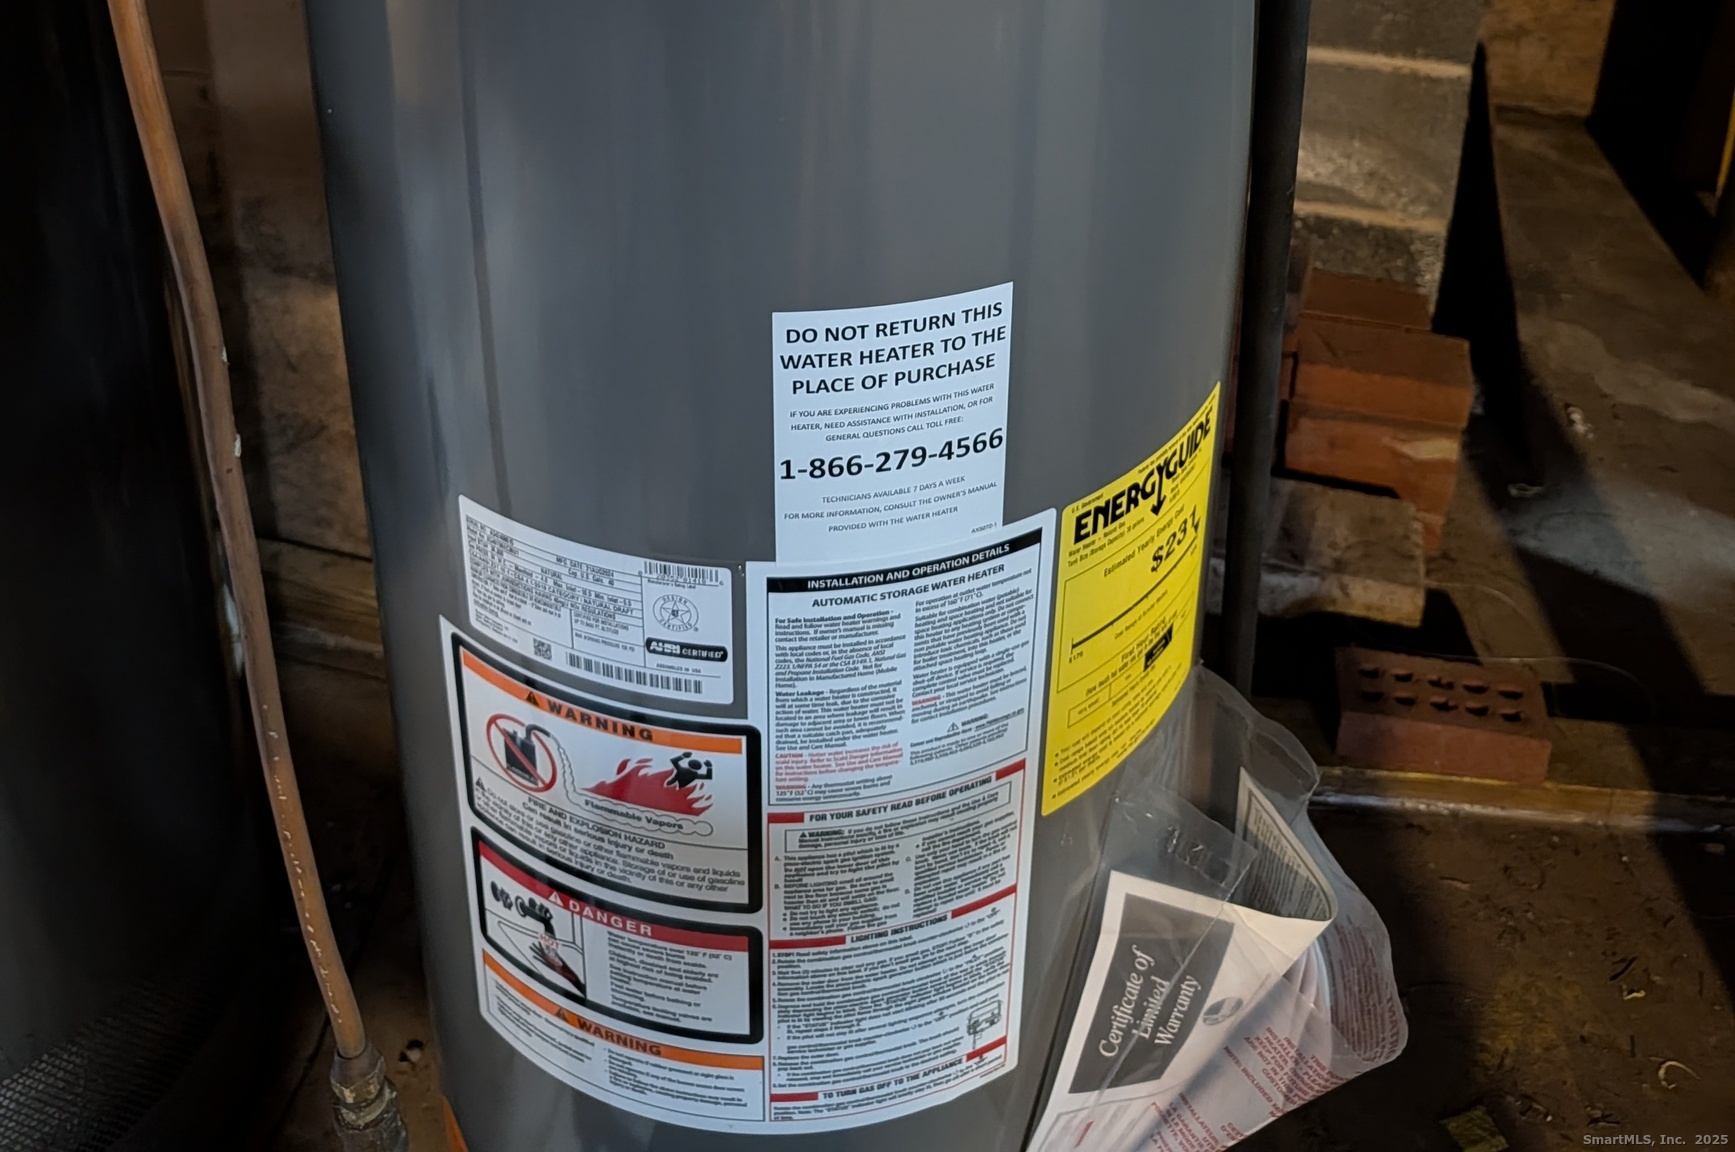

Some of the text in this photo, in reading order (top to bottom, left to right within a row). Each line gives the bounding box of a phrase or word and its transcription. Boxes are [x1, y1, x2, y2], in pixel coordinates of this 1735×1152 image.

[786, 302, 1003, 344] DO NOT RETURN THIS
[780, 325, 1007, 369] WATER HEATER TO THE
[792, 353, 996, 395] PLACE OF PURCHASE
[790, 396, 993, 431] HEATER, NEED ASSISTANCE WITH INSTALLATION, OR FOR
[799, 410, 816, 418] YOU
[816, 409, 832, 417] ARE
[834, 403, 889, 416] EXPERIENCING
[891, 397, 931, 410] PROBLEMS
[932, 393, 952, 402] WITH
[954, 389, 969, 398] THIS
[970, 383, 995, 394] WATER
[825, 415, 964, 442] GENERAL QUESTIONS CALL TOLL FREE:
[780, 427, 1003, 480] 1-866-279-4566
[822, 492, 872, 504] TECHNICIANS
[873, 486, 911, 499] AVAILABLE
[913, 485, 918, 493] 7
[920, 482, 937, 491] DAYS
[945, 475, 966, 485] WEEK
[1074, 405, 1213, 545] ENERGYGUIDE
[784, 481, 998, 520] FOR MORE INFORMATION, CONSULT THE OWNER'S MANUAL
[828, 522, 867, 532] PROVIDED
[868, 520, 889, 528] WITH
[906, 512, 931, 523] WATER
[931, 506, 958, 518] HEATER
[1103, 503, 1185, 577] Estimated Yearly Energy Cost
[1151, 504, 1197, 573] $231
[807, 543, 1010, 589] INSTALLATION AND OPERATION DETAILS
[812, 563, 1005, 608] AUTOMATIC STORAGE WATER HEATER
[803, 615, 842, 623] Installation
[857, 610, 890, 619] Operation
[861, 616, 889, 625] warnings
[682, 648, 719, 659] CERTIFIED
[1121, 643, 1135, 662] First
[547, 699, 653, 741] WARNING
[584, 799, 684, 830] Flammable Vapors
[809, 775, 993, 823] FOR YOUR SAFETY READ BEFORE OPERATING
[522, 801, 538, 815] Can
[539, 811, 562, 827] result
[573, 827, 605, 844] serious
[647, 848, 674, 860] death
[528, 796, 666, 849] FIRE AND EXPLOSION HAZARD
[569, 900, 652, 937] DANGER
[850, 914, 948, 943] LIGHTING INSTRUCTIONS
[540, 933, 559, 949] HOT
[1098, 944, 1155, 1057] Certificate of
[1131, 975, 1170, 1039] Limited
[1154, 975, 1202, 1045] Warranty
[577, 1019, 662, 1057] WARNING
[1243, 1037, 1279, 1076] ARE NOT IN
[1254, 1036, 1285, 1071] KEEP FOR
[1264, 1036, 1289, 1066] HEATER.
[1266, 1026, 1299, 1067] INSTALLER
[836, 1088, 857, 1099] TURN
[859, 1085, 876, 1094] GAS
[877, 1081, 892, 1091] OFF
[894, 1078, 904, 1087] TO
[906, 1073, 921, 1084] THE
[922, 1057, 964, 1079] APPLIANCE
[1224, 1046, 1273, 1103] NOTE: INCLUDED
[1284, 1036, 1330, 1083] INSTALLATION
[1310, 1054, 1328, 1071] THIS
[1262, 1068, 1298, 1106] CUSTOMER
